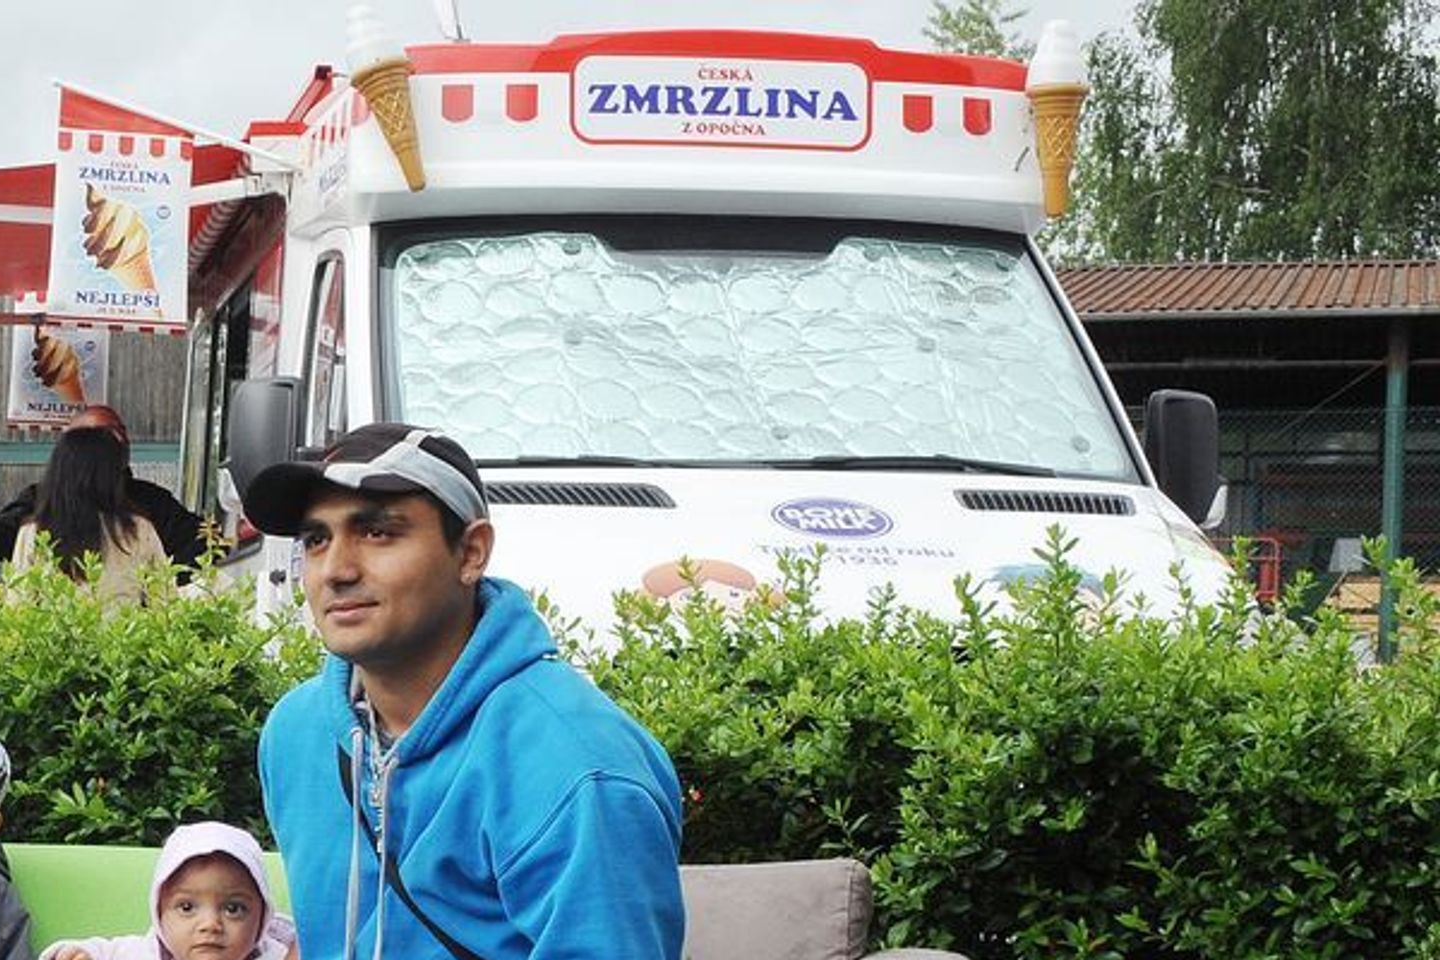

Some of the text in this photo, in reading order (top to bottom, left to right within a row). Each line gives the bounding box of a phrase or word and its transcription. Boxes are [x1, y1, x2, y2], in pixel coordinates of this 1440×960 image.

[698, 65, 754, 82] ČESKÁ
[587, 83, 859, 121] ZMRZLINA
[681, 121, 766, 136] Z OPOČNA
[78, 167, 172, 186] ZMRZLINA
